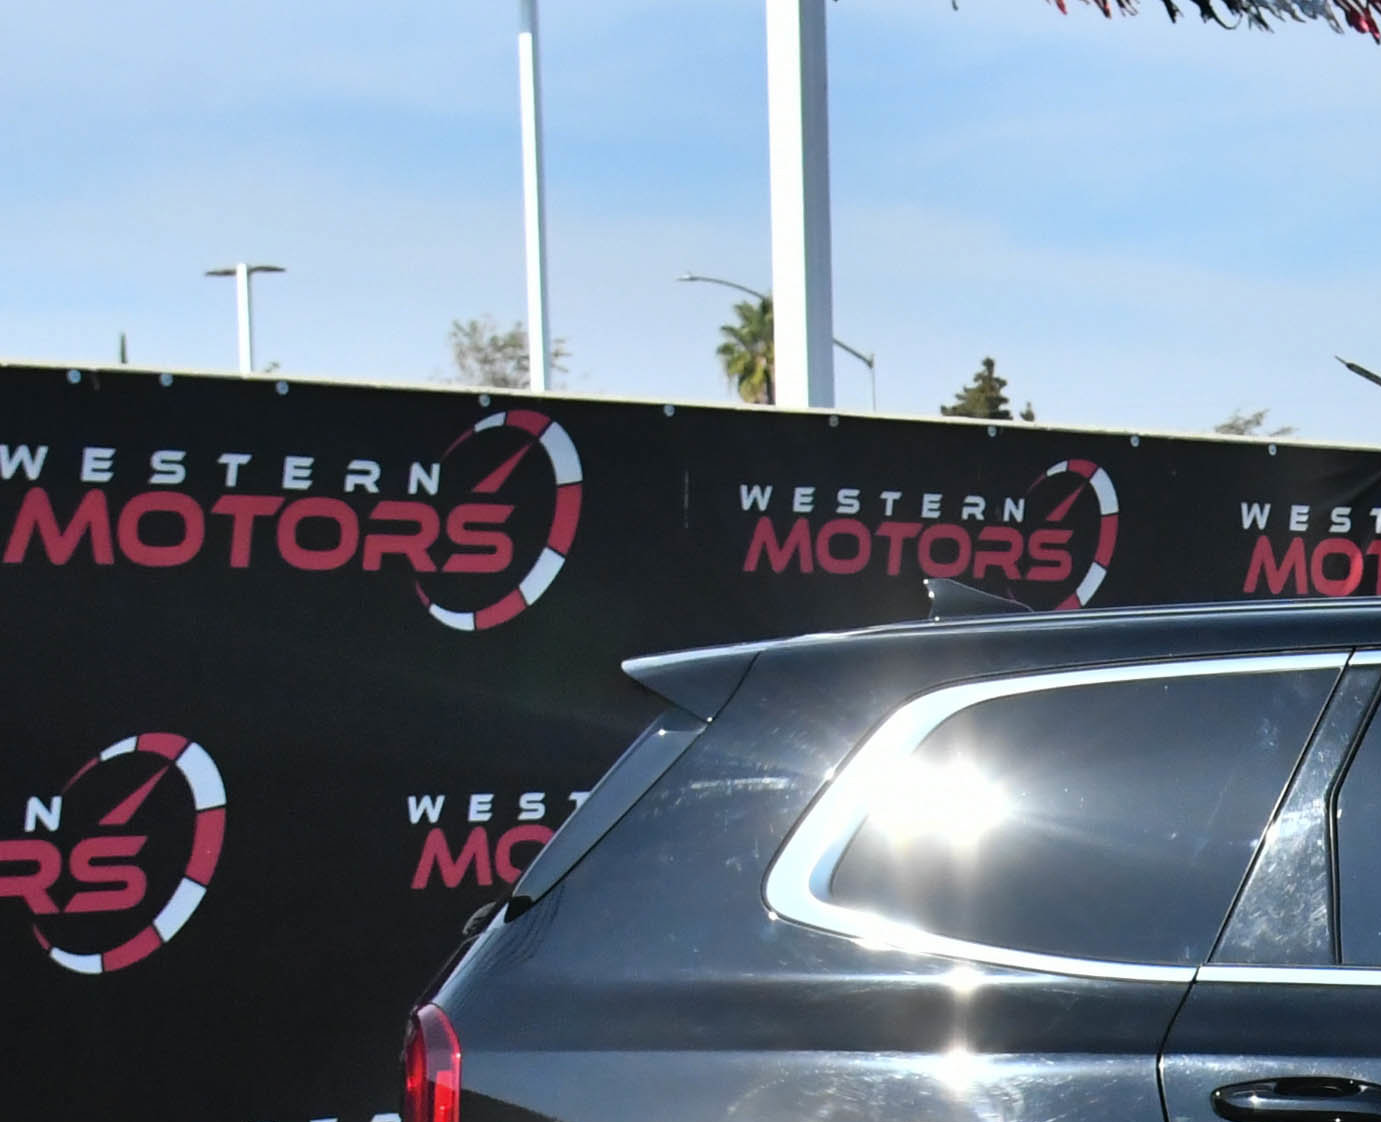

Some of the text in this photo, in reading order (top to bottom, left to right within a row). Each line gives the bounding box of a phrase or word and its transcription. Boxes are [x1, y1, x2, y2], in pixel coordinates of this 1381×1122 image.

[0, 443, 441, 496] WESTERN
[2, 485, 515, 574] MOTORS
[739, 483, 1026, 523] WESTERN
[742, 515, 1074, 582] MOTORS
